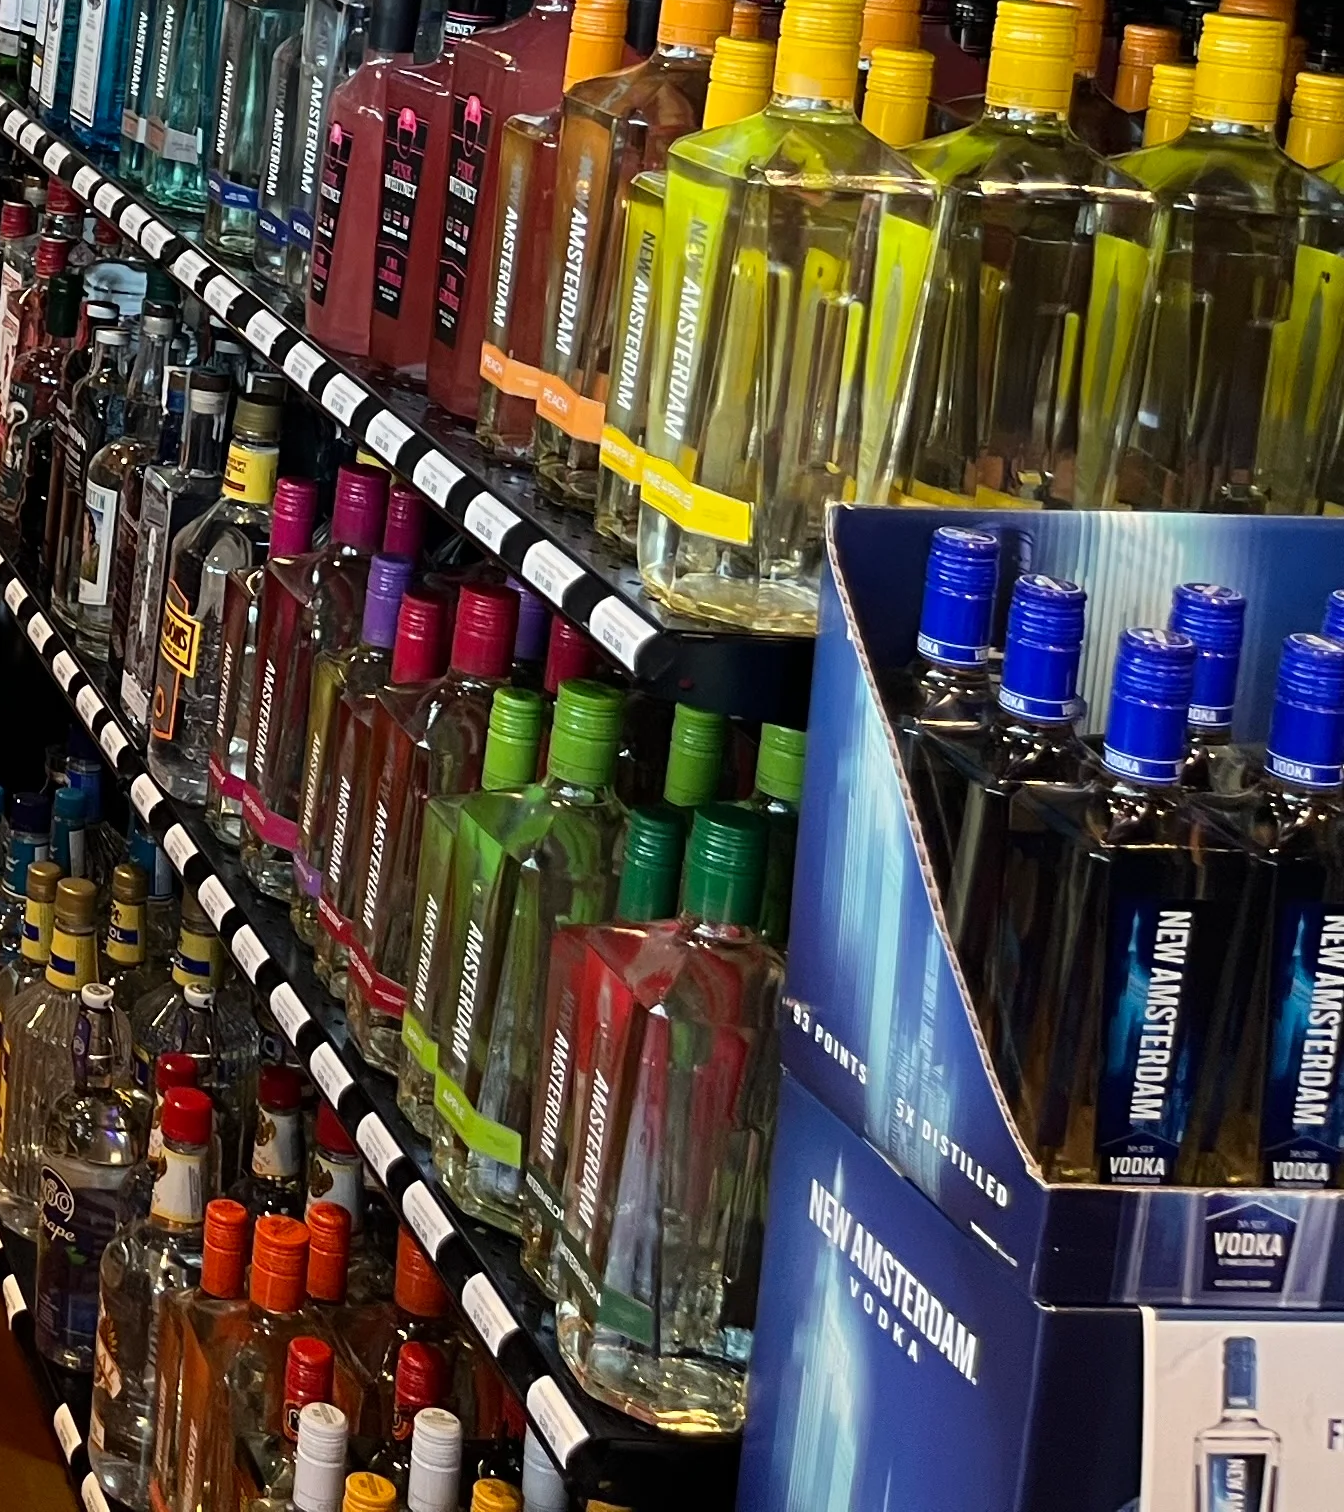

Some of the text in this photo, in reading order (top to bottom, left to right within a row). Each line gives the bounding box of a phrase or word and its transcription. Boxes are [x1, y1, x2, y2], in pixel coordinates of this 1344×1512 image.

[130, 11, 149, 97] AMSTERDAM
[155, 4, 176, 100] AMSTERDAM
[215, 59, 235, 156] AMSTERDAM
[266, 107, 286, 197] AMSTERDAM
[300, 75, 325, 196] AMSTERDAM
[493, 206, 520, 328] AMSTERDAM
[556, 206, 590, 357] AMSTERDAM
[542, 386, 569, 414] PEACH
[616, 276, 650, 411] AMSTERDAM
[664, 275, 701, 441] AMSTERDAM
[215, 642, 234, 738] AMSTERDAM
[253, 658, 277, 774] AMSTERDAM
[1272, 757, 1312, 780] VODKA
[328, 776, 352, 883] AMSTERDAM
[362, 799, 388, 930] AMSTERDAM
[413, 893, 438, 1012] AMSTERDAM
[451, 919, 484, 1065] AMSTERDAM
[792, 1003, 868, 1085] 93 POINTS
[1128, 910, 1193, 1123] NEW AMSTERDAM
[1293, 968, 1343, 1126] AMSTERDAM
[540, 1028, 572, 1161] AMSTERDAM
[577, 1067, 610, 1230] AMSTERDAM
[894, 1097, 1009, 1208] 5X DISTILLED
[1109, 1156, 1166, 1177] VODKA
[1272, 1161, 1331, 1182] VODKA
[809, 1178, 978, 1377] NEW AMSTERDAM
[1213, 1232, 1284, 1258] VODKA
[849, 1275, 919, 1364] VODKA
